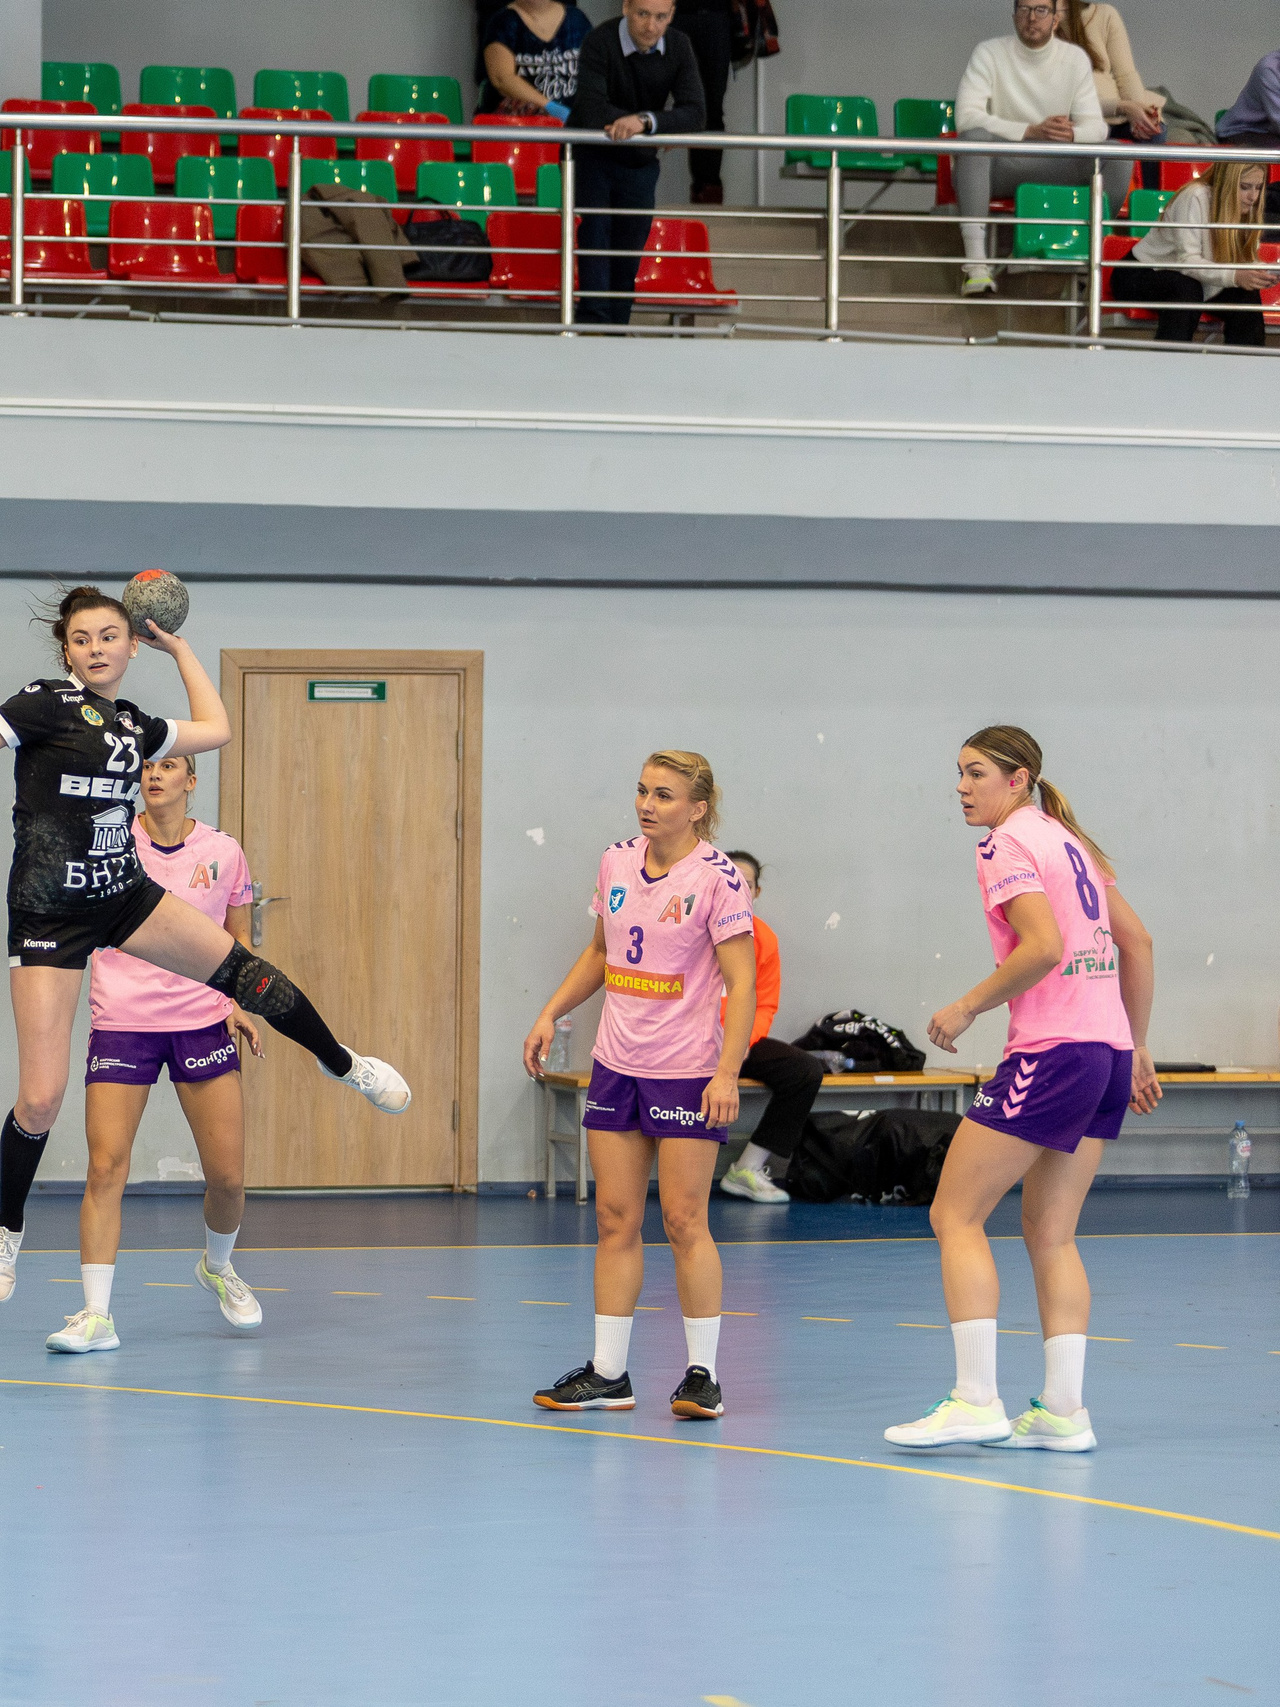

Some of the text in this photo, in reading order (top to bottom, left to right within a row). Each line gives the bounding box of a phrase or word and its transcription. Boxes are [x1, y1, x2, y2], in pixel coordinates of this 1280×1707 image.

[104, 731, 140, 773] 23
[100, 882, 124, 898] 1920
[1064, 841, 1100, 921] 8
[23, 938, 57, 950] Kempa
[626, 925, 644, 965] 3
[608, 972, 683, 993] КОПЕЕЧКА
